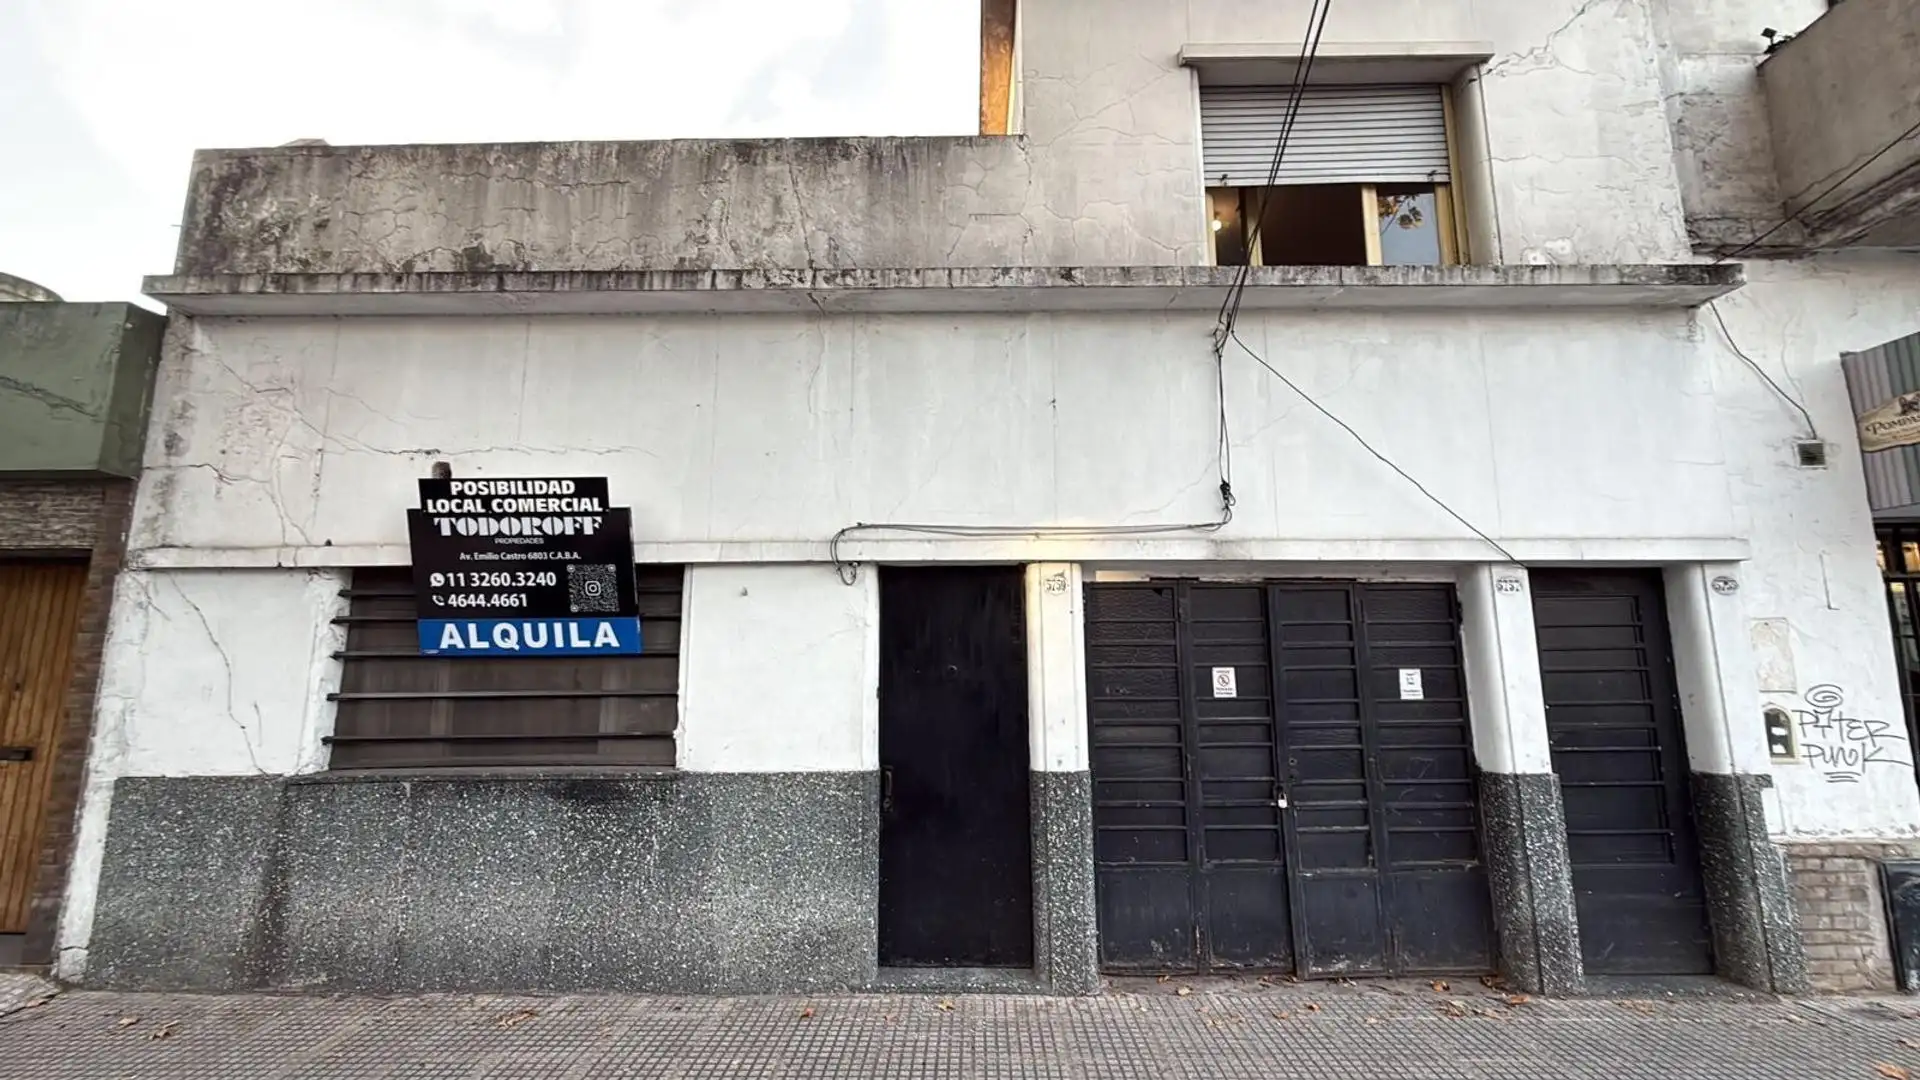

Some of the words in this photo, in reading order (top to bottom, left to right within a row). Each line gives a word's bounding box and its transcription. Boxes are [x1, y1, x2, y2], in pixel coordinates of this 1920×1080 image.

[451, 480, 575, 496] POSIBILIDAD
[426, 498, 486, 514] LOCAL
[491, 497, 603, 513] COMERCIAL
[433, 516, 602, 536] TODOROFF
[494, 537, 545, 545] PROPIEDADES
[459, 552, 474, 561] Av.
[474, 552, 499, 560] Emilio
[500, 551, 527, 560] Castro
[549, 551, 581, 560] C.A.B.A.
[446, 572, 466, 587] 11
[470, 571, 557, 587] 3260.3240
[447, 593, 528, 607] 4644.4661
[439, 621, 620, 651] ALQUILA
